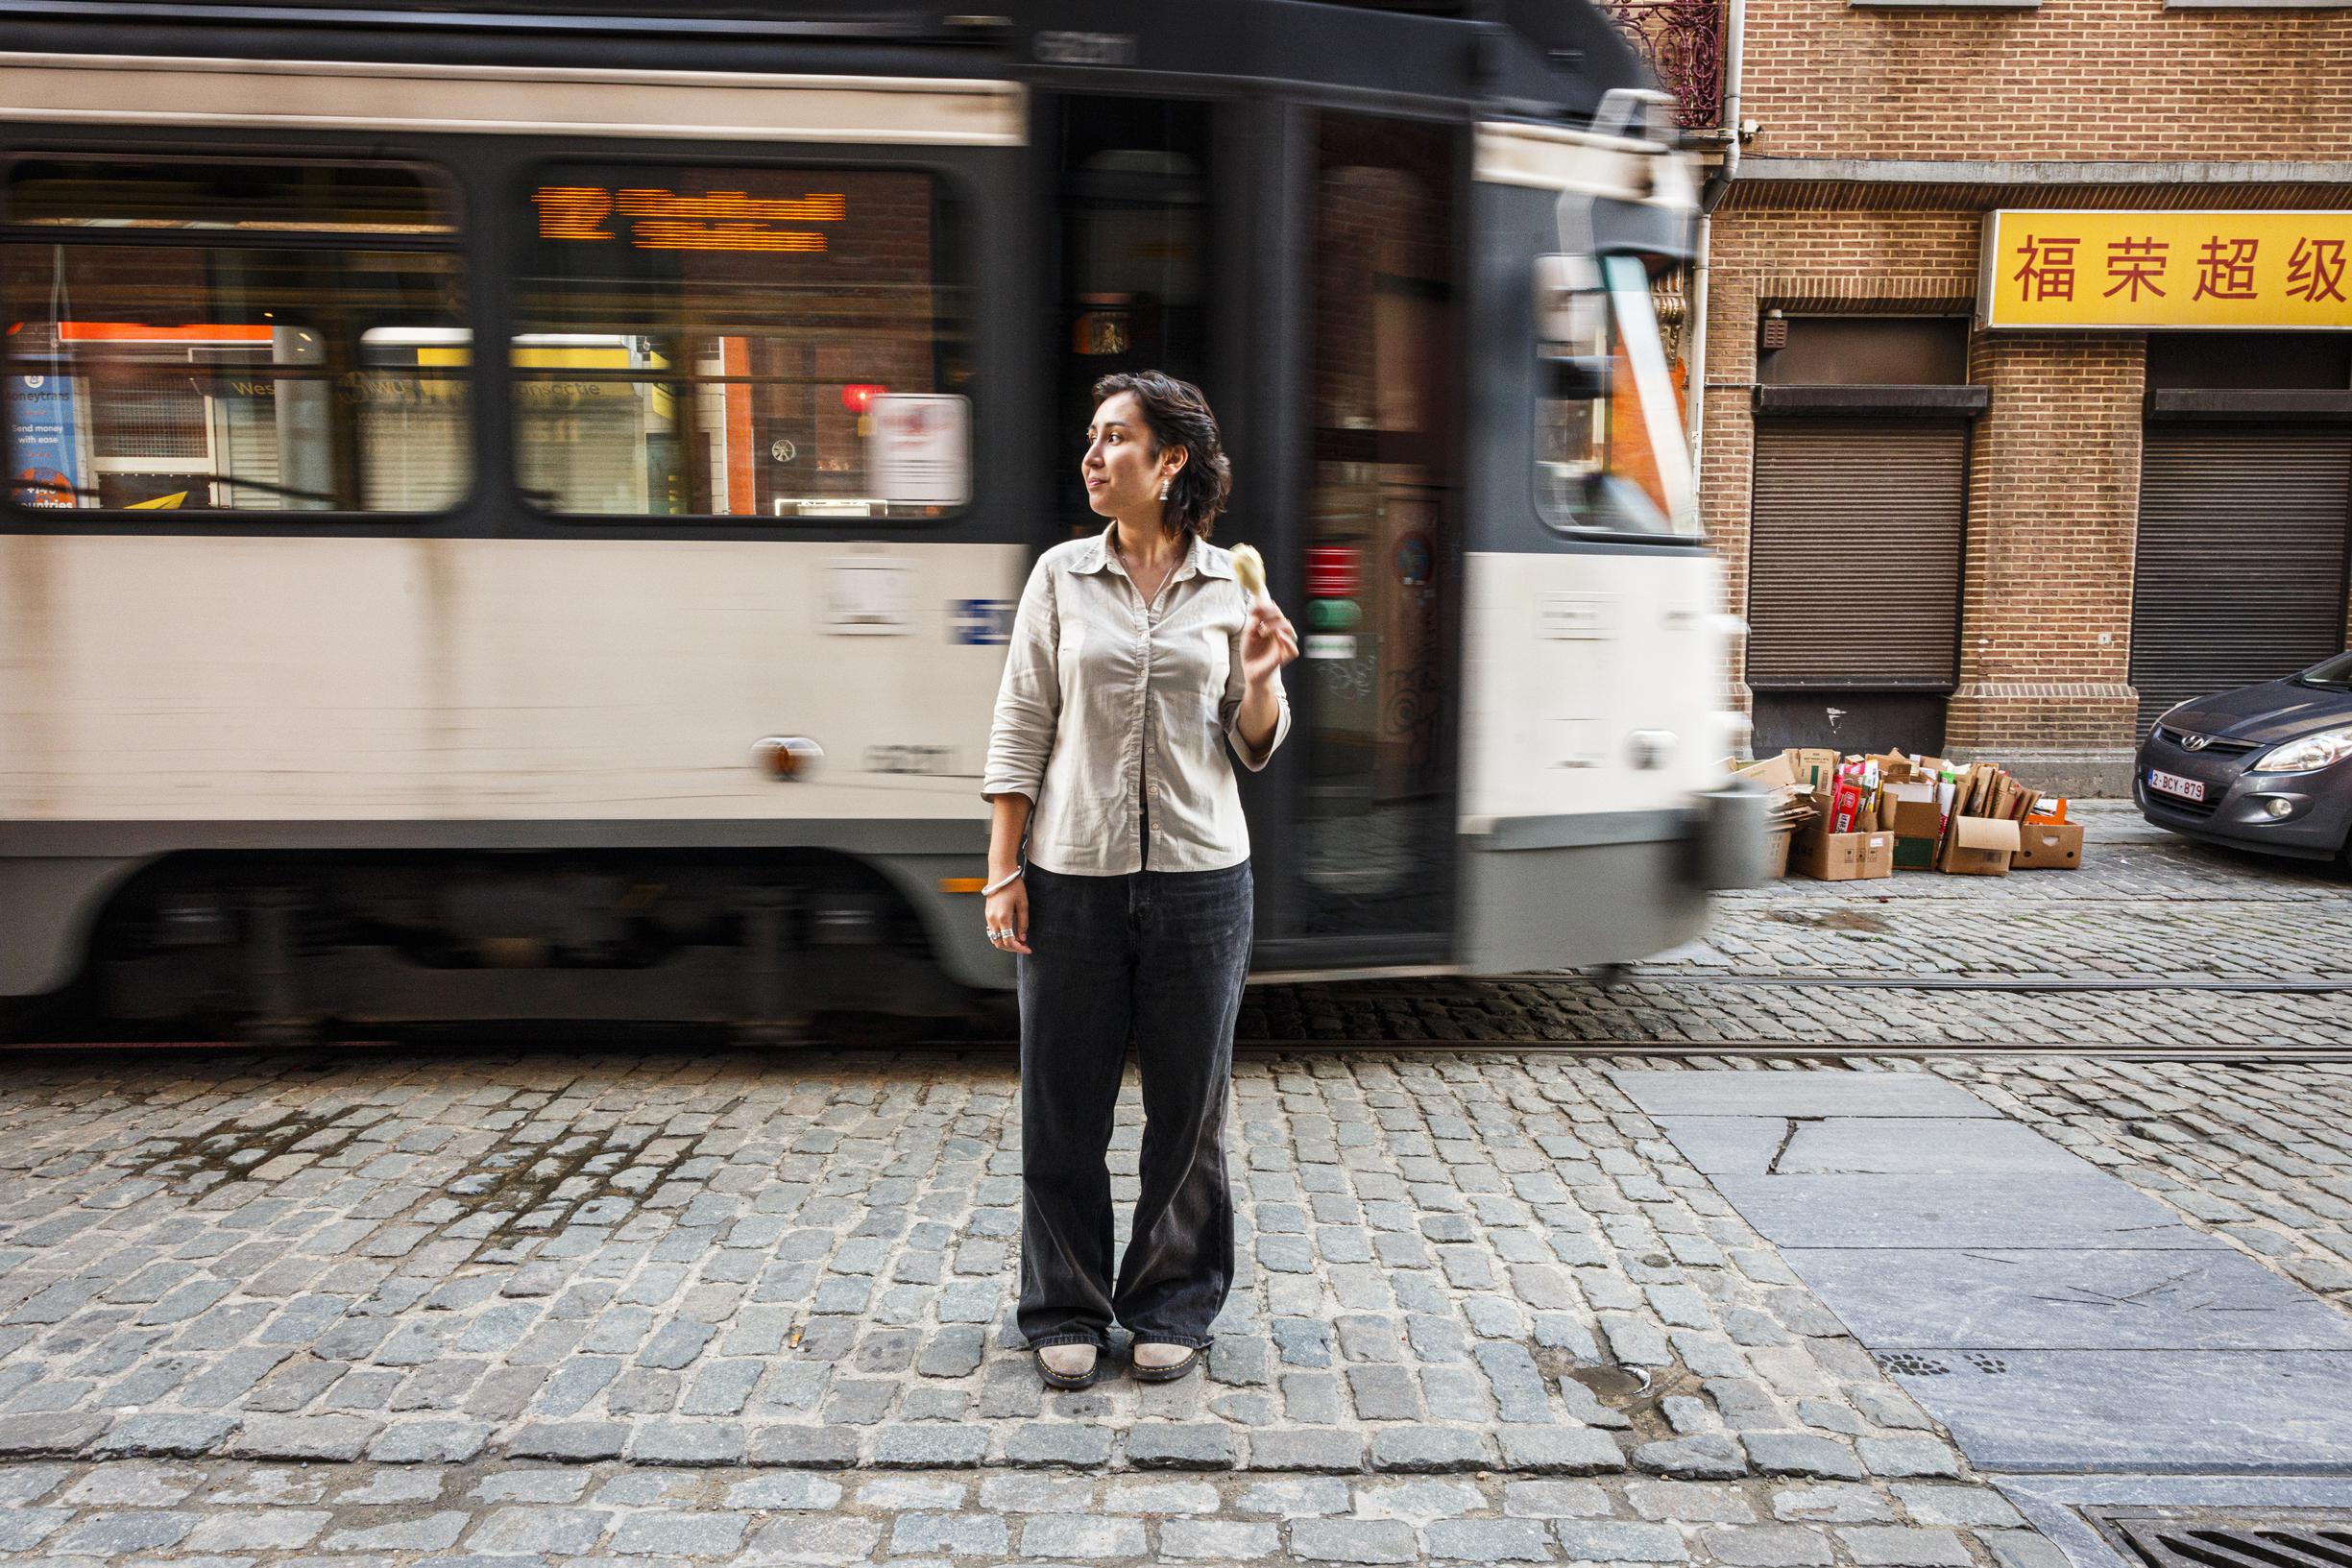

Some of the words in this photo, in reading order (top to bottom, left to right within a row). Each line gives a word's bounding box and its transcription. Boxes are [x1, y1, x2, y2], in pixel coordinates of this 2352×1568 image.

[2013, 234, 2347, 302] 福荣超级
[12, 424, 33, 433] Send
[35, 425, 63, 435] money
[2152, 773, 2202, 798] 2-BCY-879
